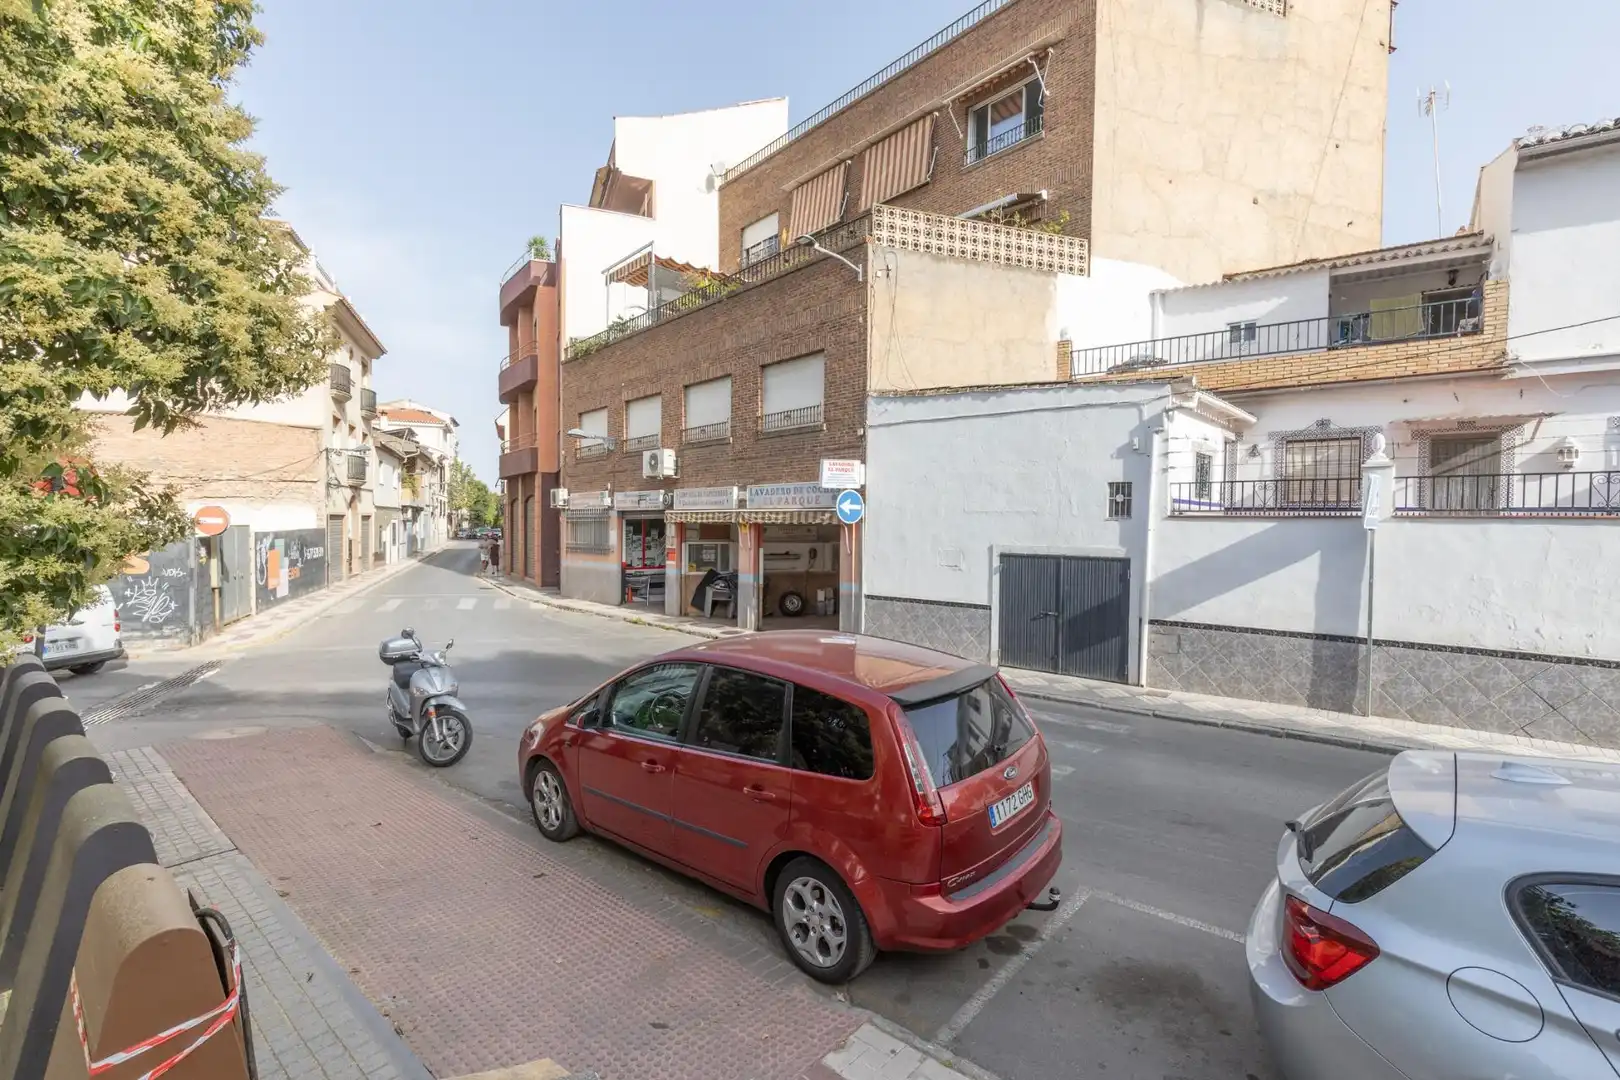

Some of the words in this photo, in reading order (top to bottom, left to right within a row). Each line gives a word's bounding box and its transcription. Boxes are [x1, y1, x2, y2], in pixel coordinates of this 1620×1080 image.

[749, 486, 791, 497] LAVADERO
[793, 486, 805, 495] DE
[763, 496, 775, 506] EL
[777, 495, 822, 507] PARQUE
[996, 794, 1018, 820] 1172
[1018, 784, 1032, 805] GHG
